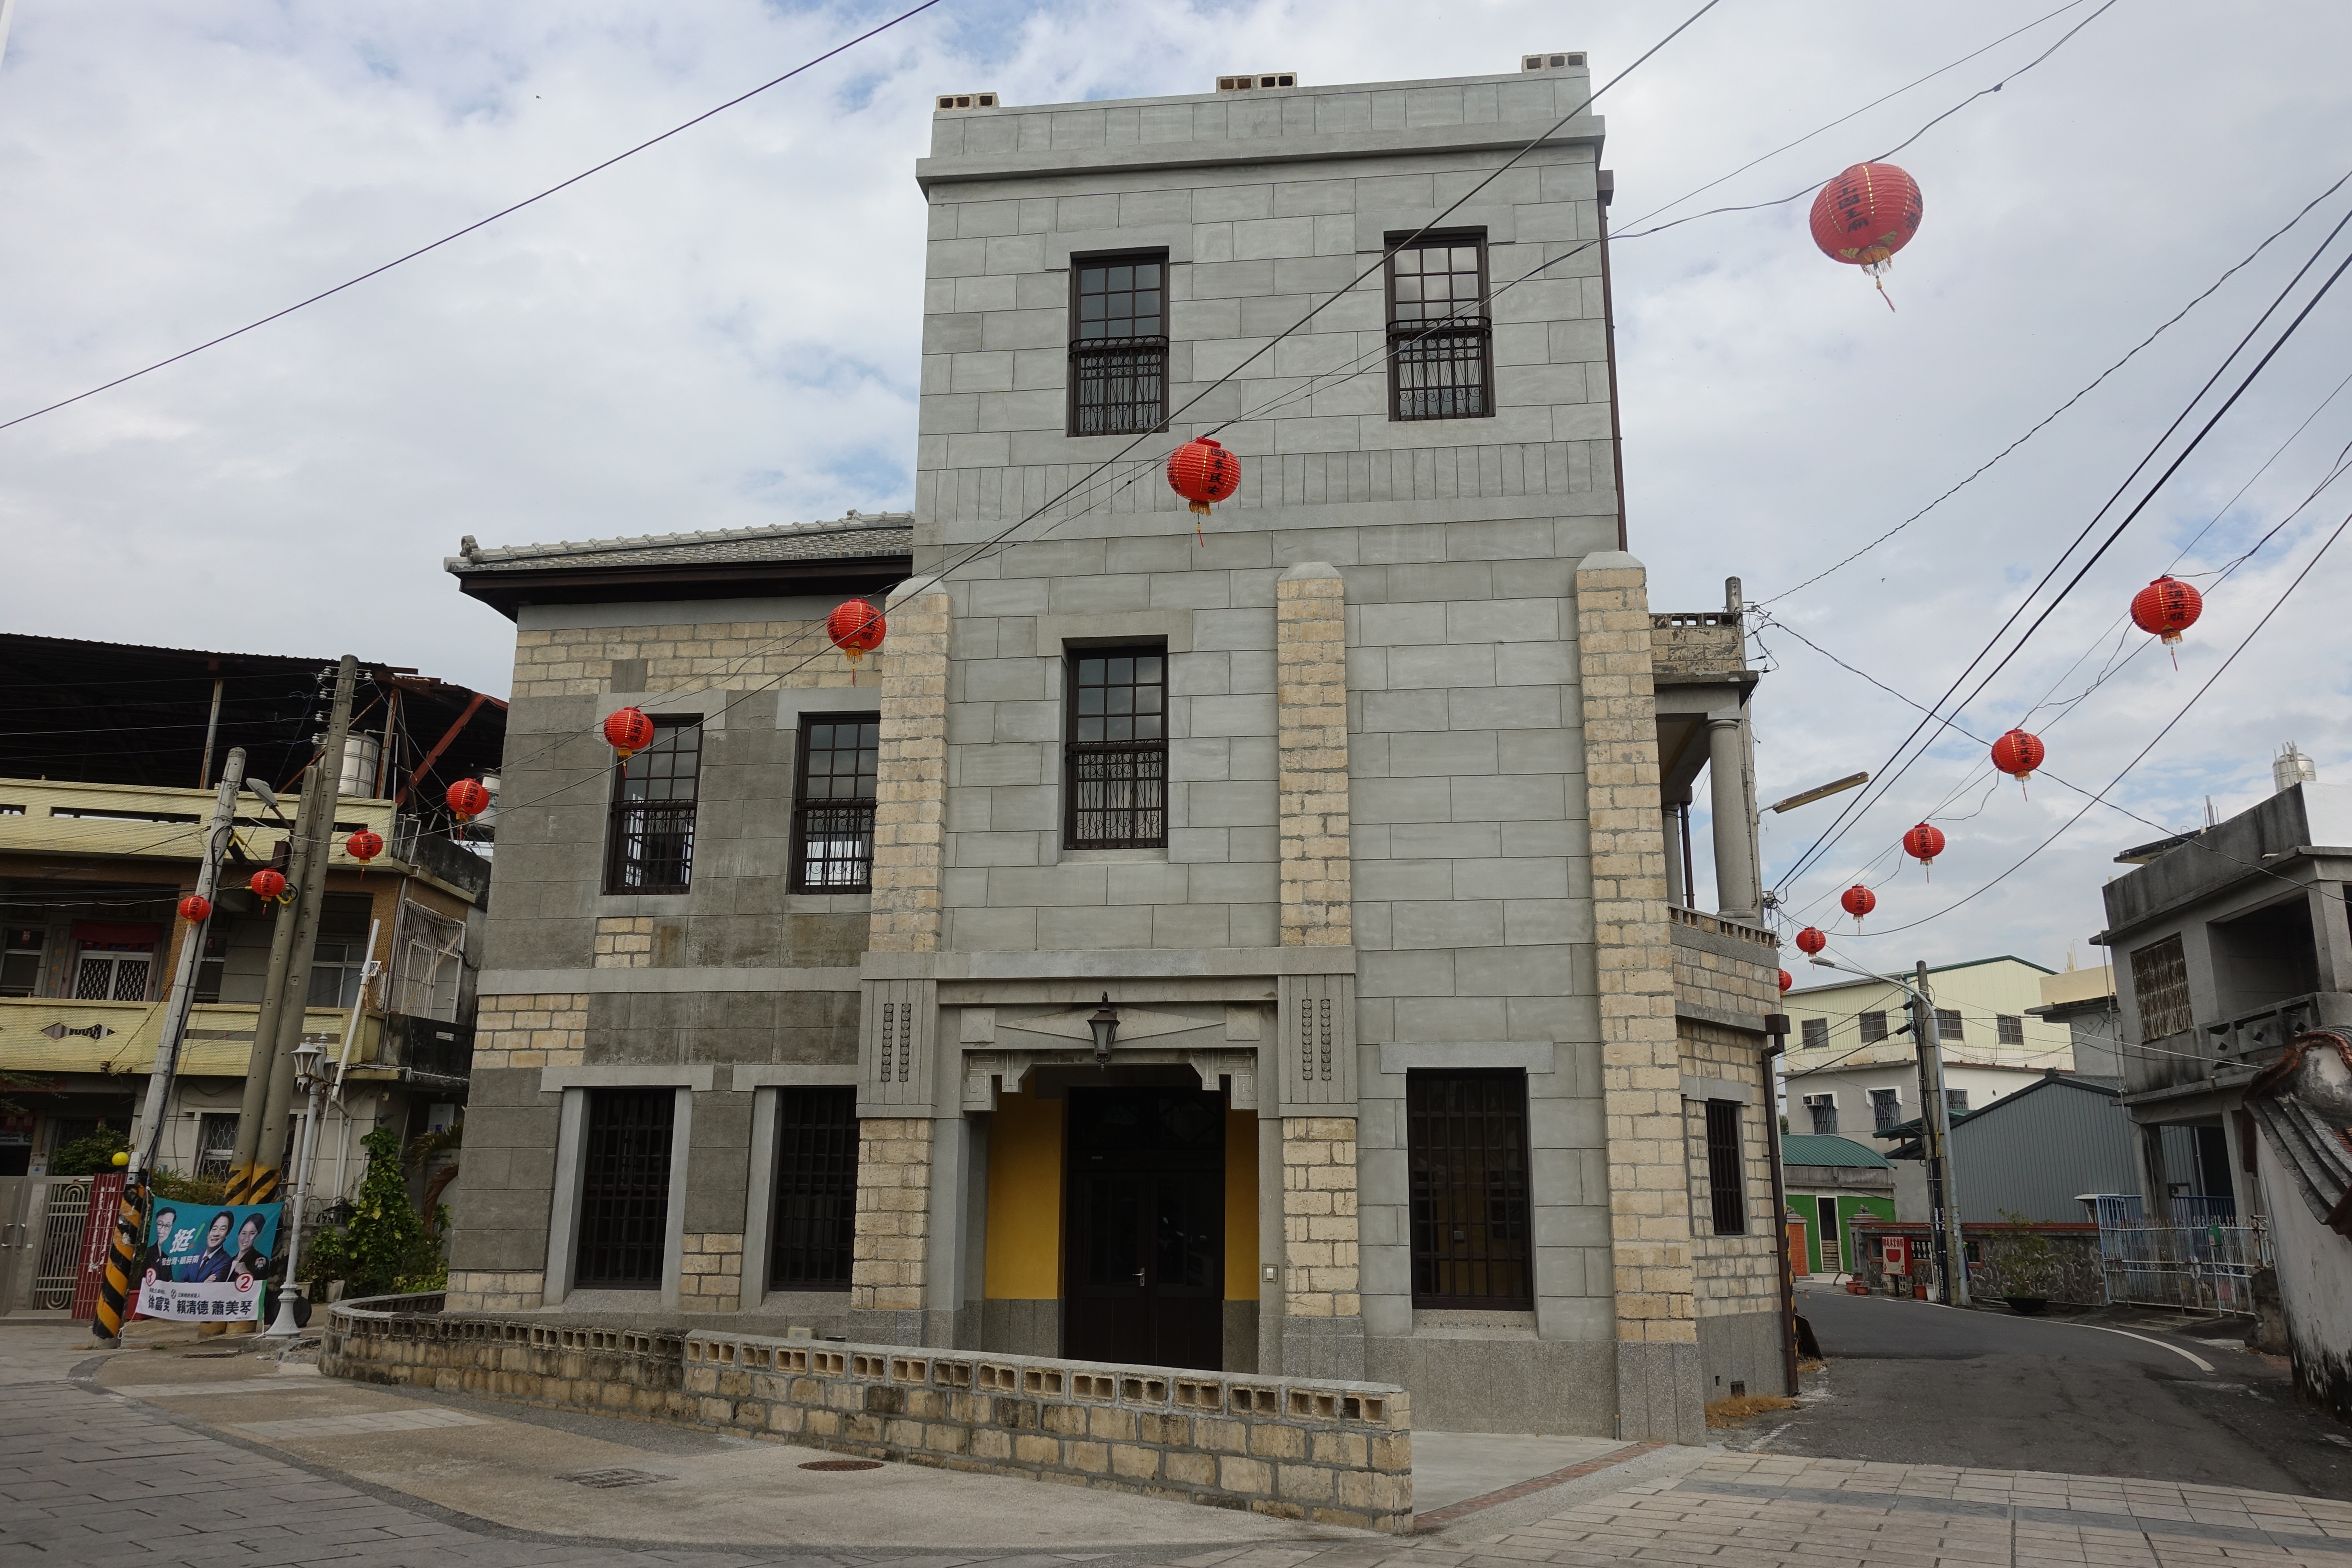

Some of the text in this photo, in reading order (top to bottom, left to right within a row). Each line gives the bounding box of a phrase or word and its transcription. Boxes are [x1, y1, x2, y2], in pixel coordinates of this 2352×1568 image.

[1204, 448, 1227, 496] 國泰民安
[2165, 583, 2185, 621] 風調雨順
[860, 605, 877, 642] 風調雨順
[628, 713, 643, 743] 風調雨順
[2015, 734, 2032, 763] 國泰民安
[464, 783, 479, 808] 風調雨順
[1917, 829, 1931, 854] 國泰民安
[147, 1270, 153, 1283] 3
[239, 1277, 250, 1289] 2
[177, 1299, 253, 1315] 賴清德 蕭美琴
